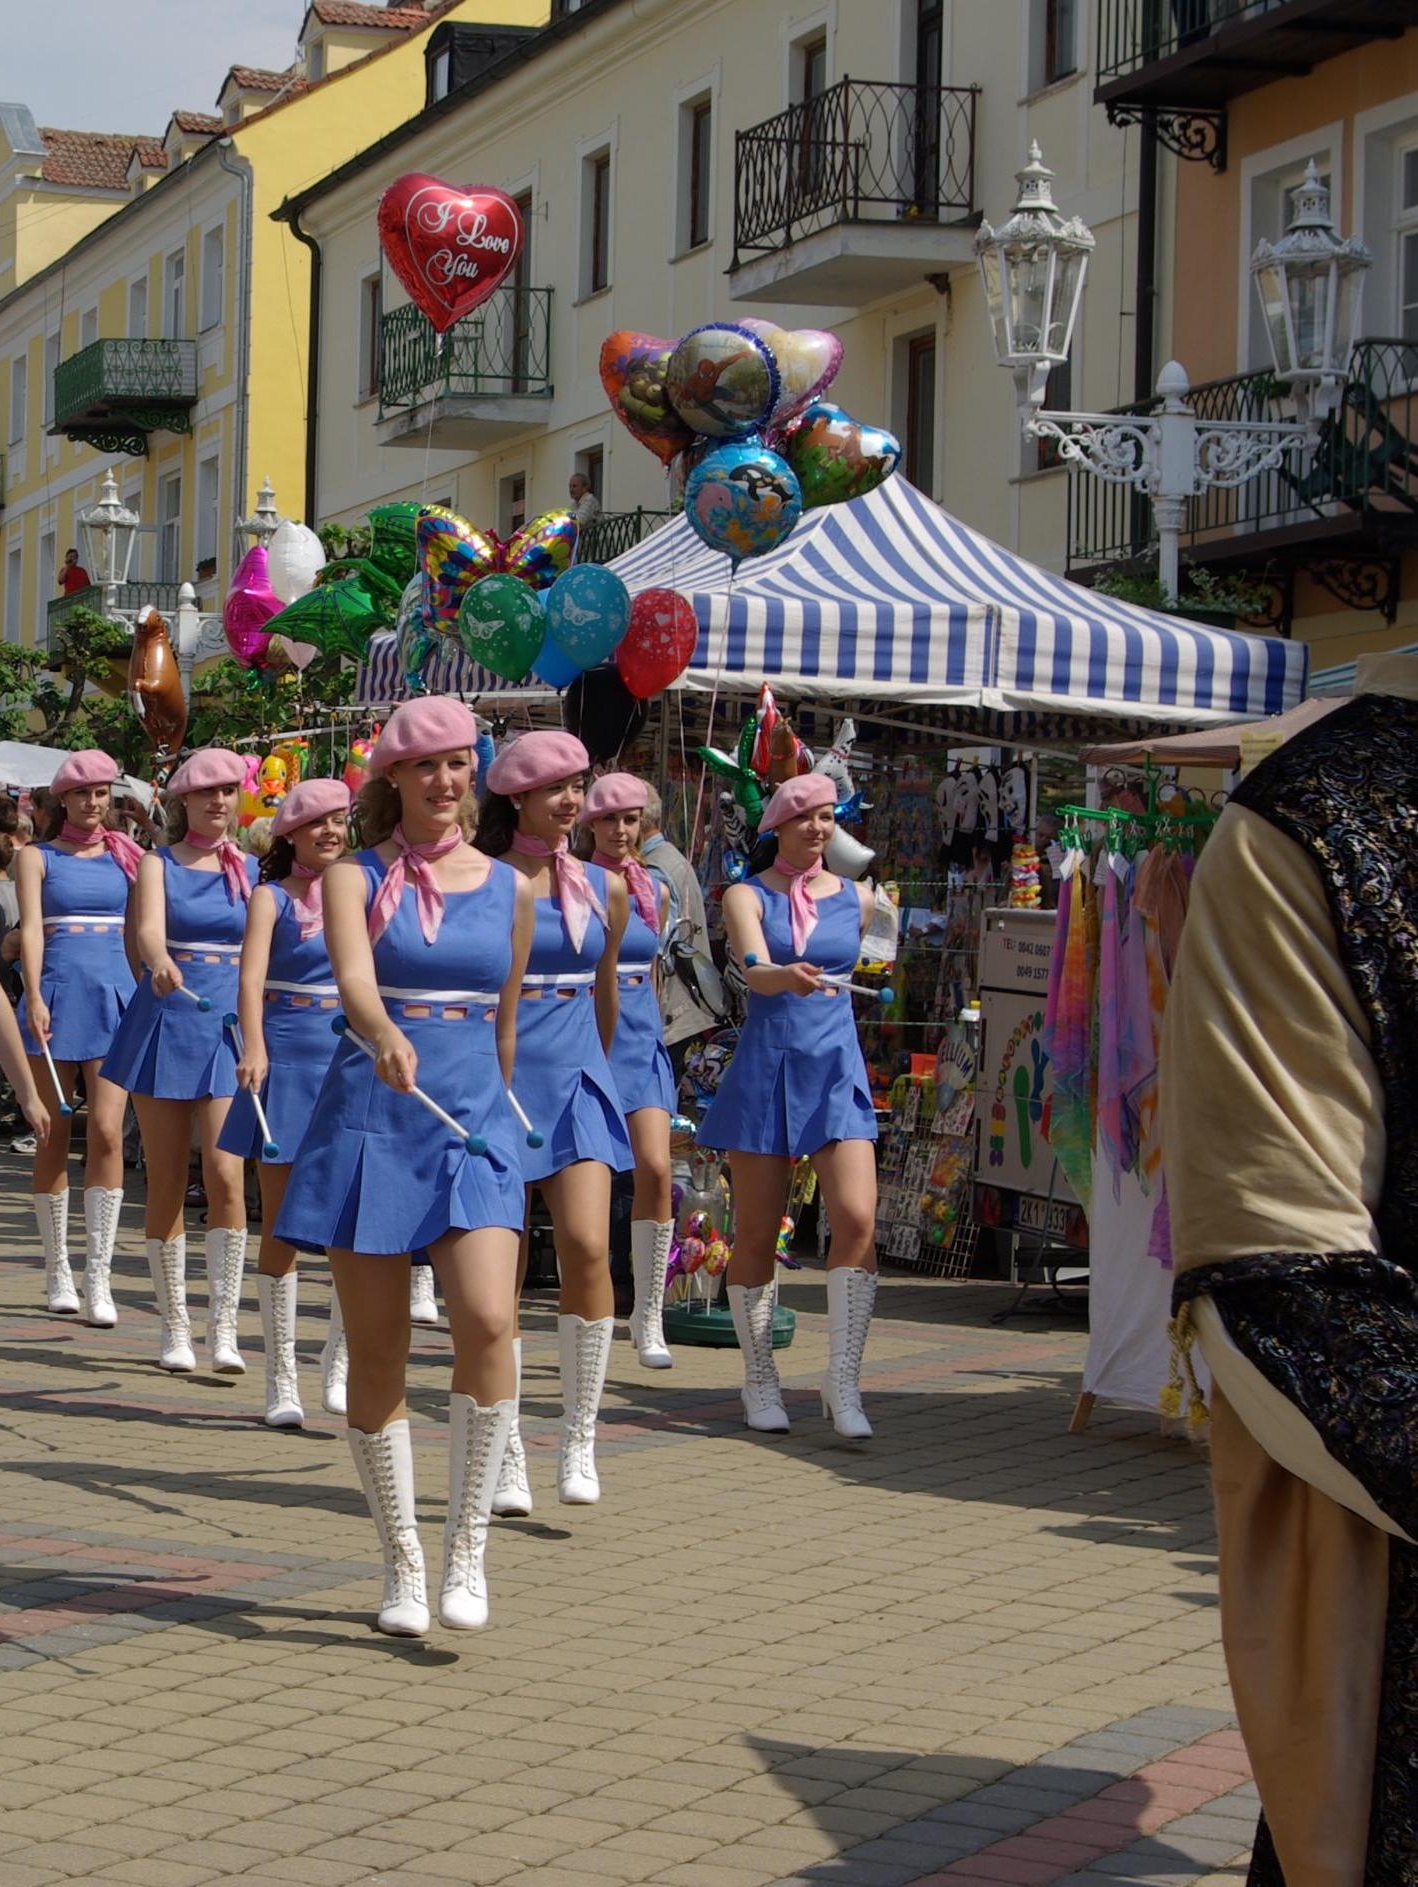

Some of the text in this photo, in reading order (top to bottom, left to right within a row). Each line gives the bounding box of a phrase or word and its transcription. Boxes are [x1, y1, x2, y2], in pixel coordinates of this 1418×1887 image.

[417, 201, 510, 254] I Love
[426, 248, 479, 286] You
